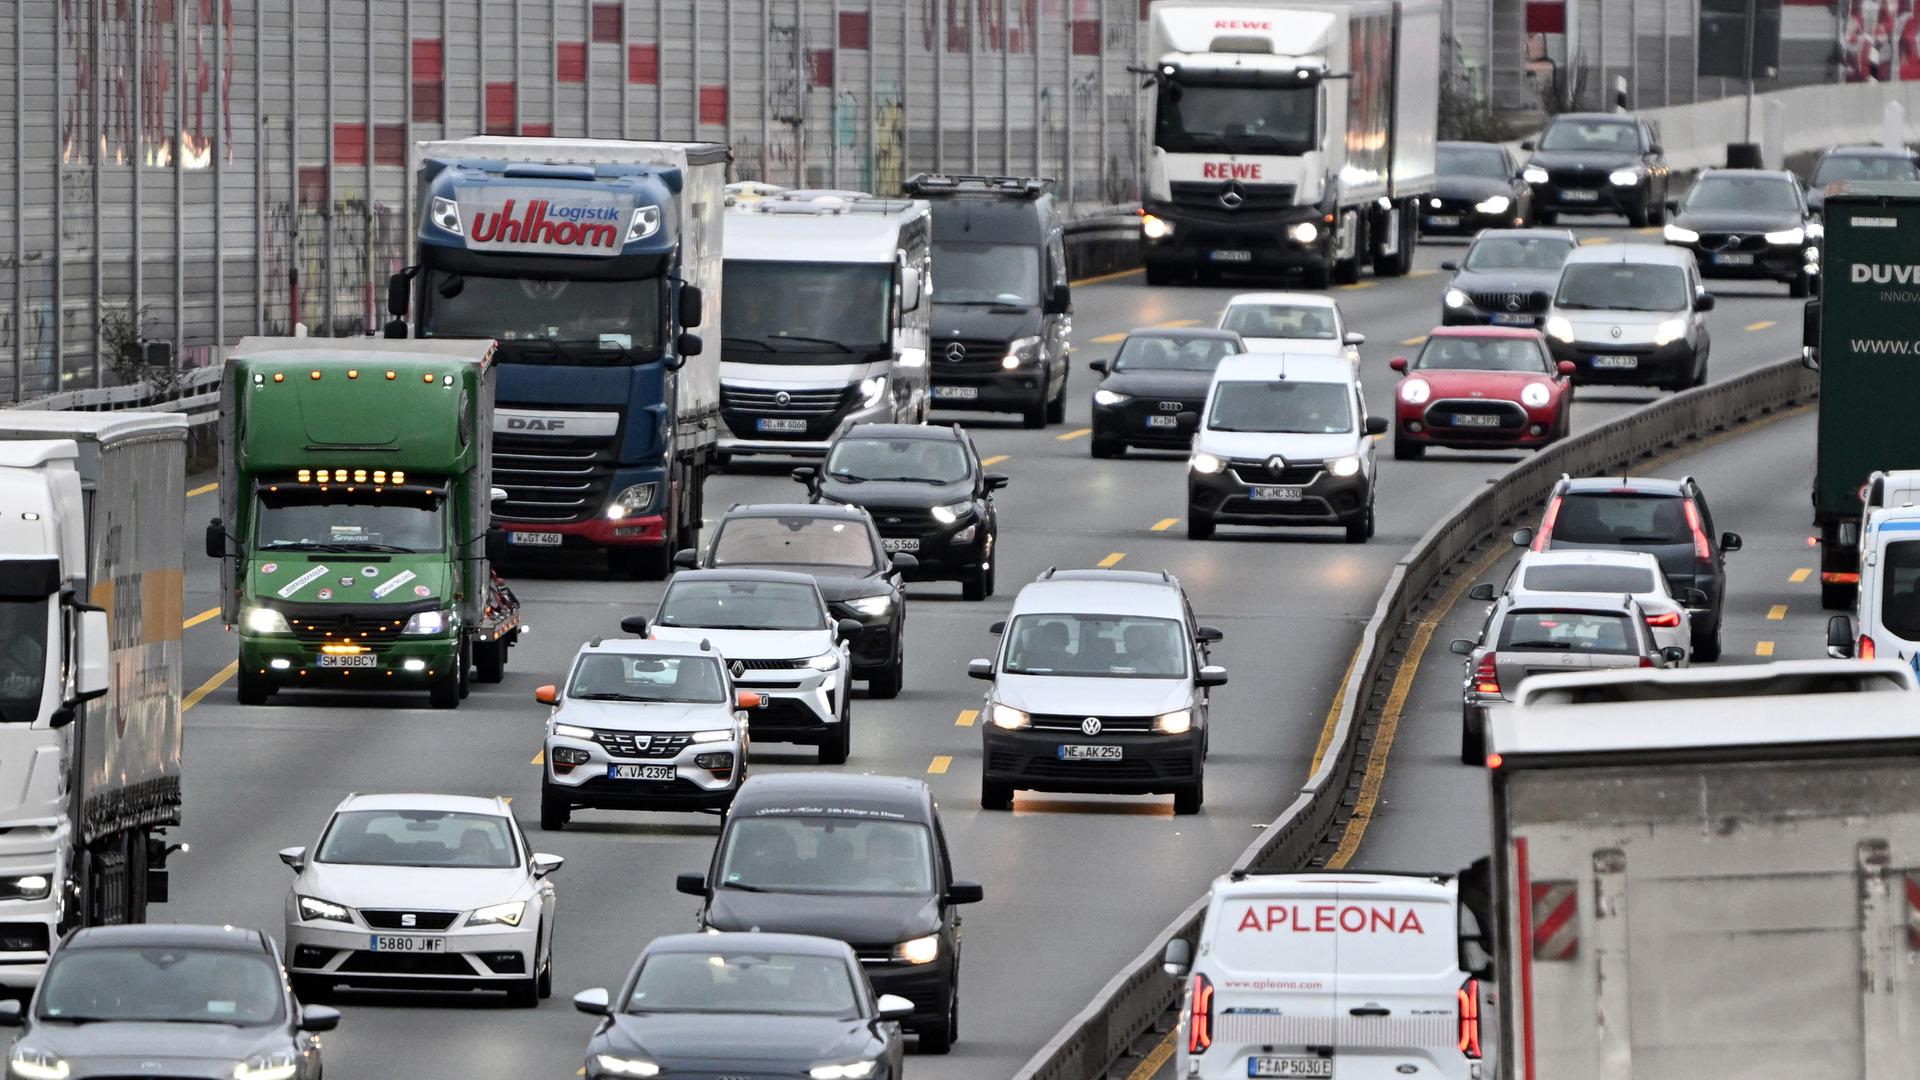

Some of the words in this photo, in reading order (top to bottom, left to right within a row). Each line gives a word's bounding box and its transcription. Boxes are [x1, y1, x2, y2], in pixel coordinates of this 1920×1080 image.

[1215, 20, 1273, 30] REWE
[1203, 162, 1262, 180] REWE
[548, 204, 619, 222] Logistik
[507, 418, 566, 431] DAF
[528, 534, 539, 543] GT
[542, 534, 559, 544] 460
[901, 540, 919, 549] 566
[323, 656, 337, 666] SM
[340, 655, 376, 666] 90BCY
[1064, 746, 1078, 757] NE
[1086, 747, 1099, 757] AK
[1101, 747, 1121, 758] 256
[616, 766, 622, 777] K
[630, 767, 644, 778] VA
[646, 767, 674, 779] 239E
[1237, 905, 1425, 934] APLEONA
[379, 937, 413, 950] 5880
[418, 938, 442, 951] JWF
[1225, 980, 1323, 990] www.apleona.com
[1257, 1060, 1264, 1072] F
[1274, 1060, 1288, 1073] AP
